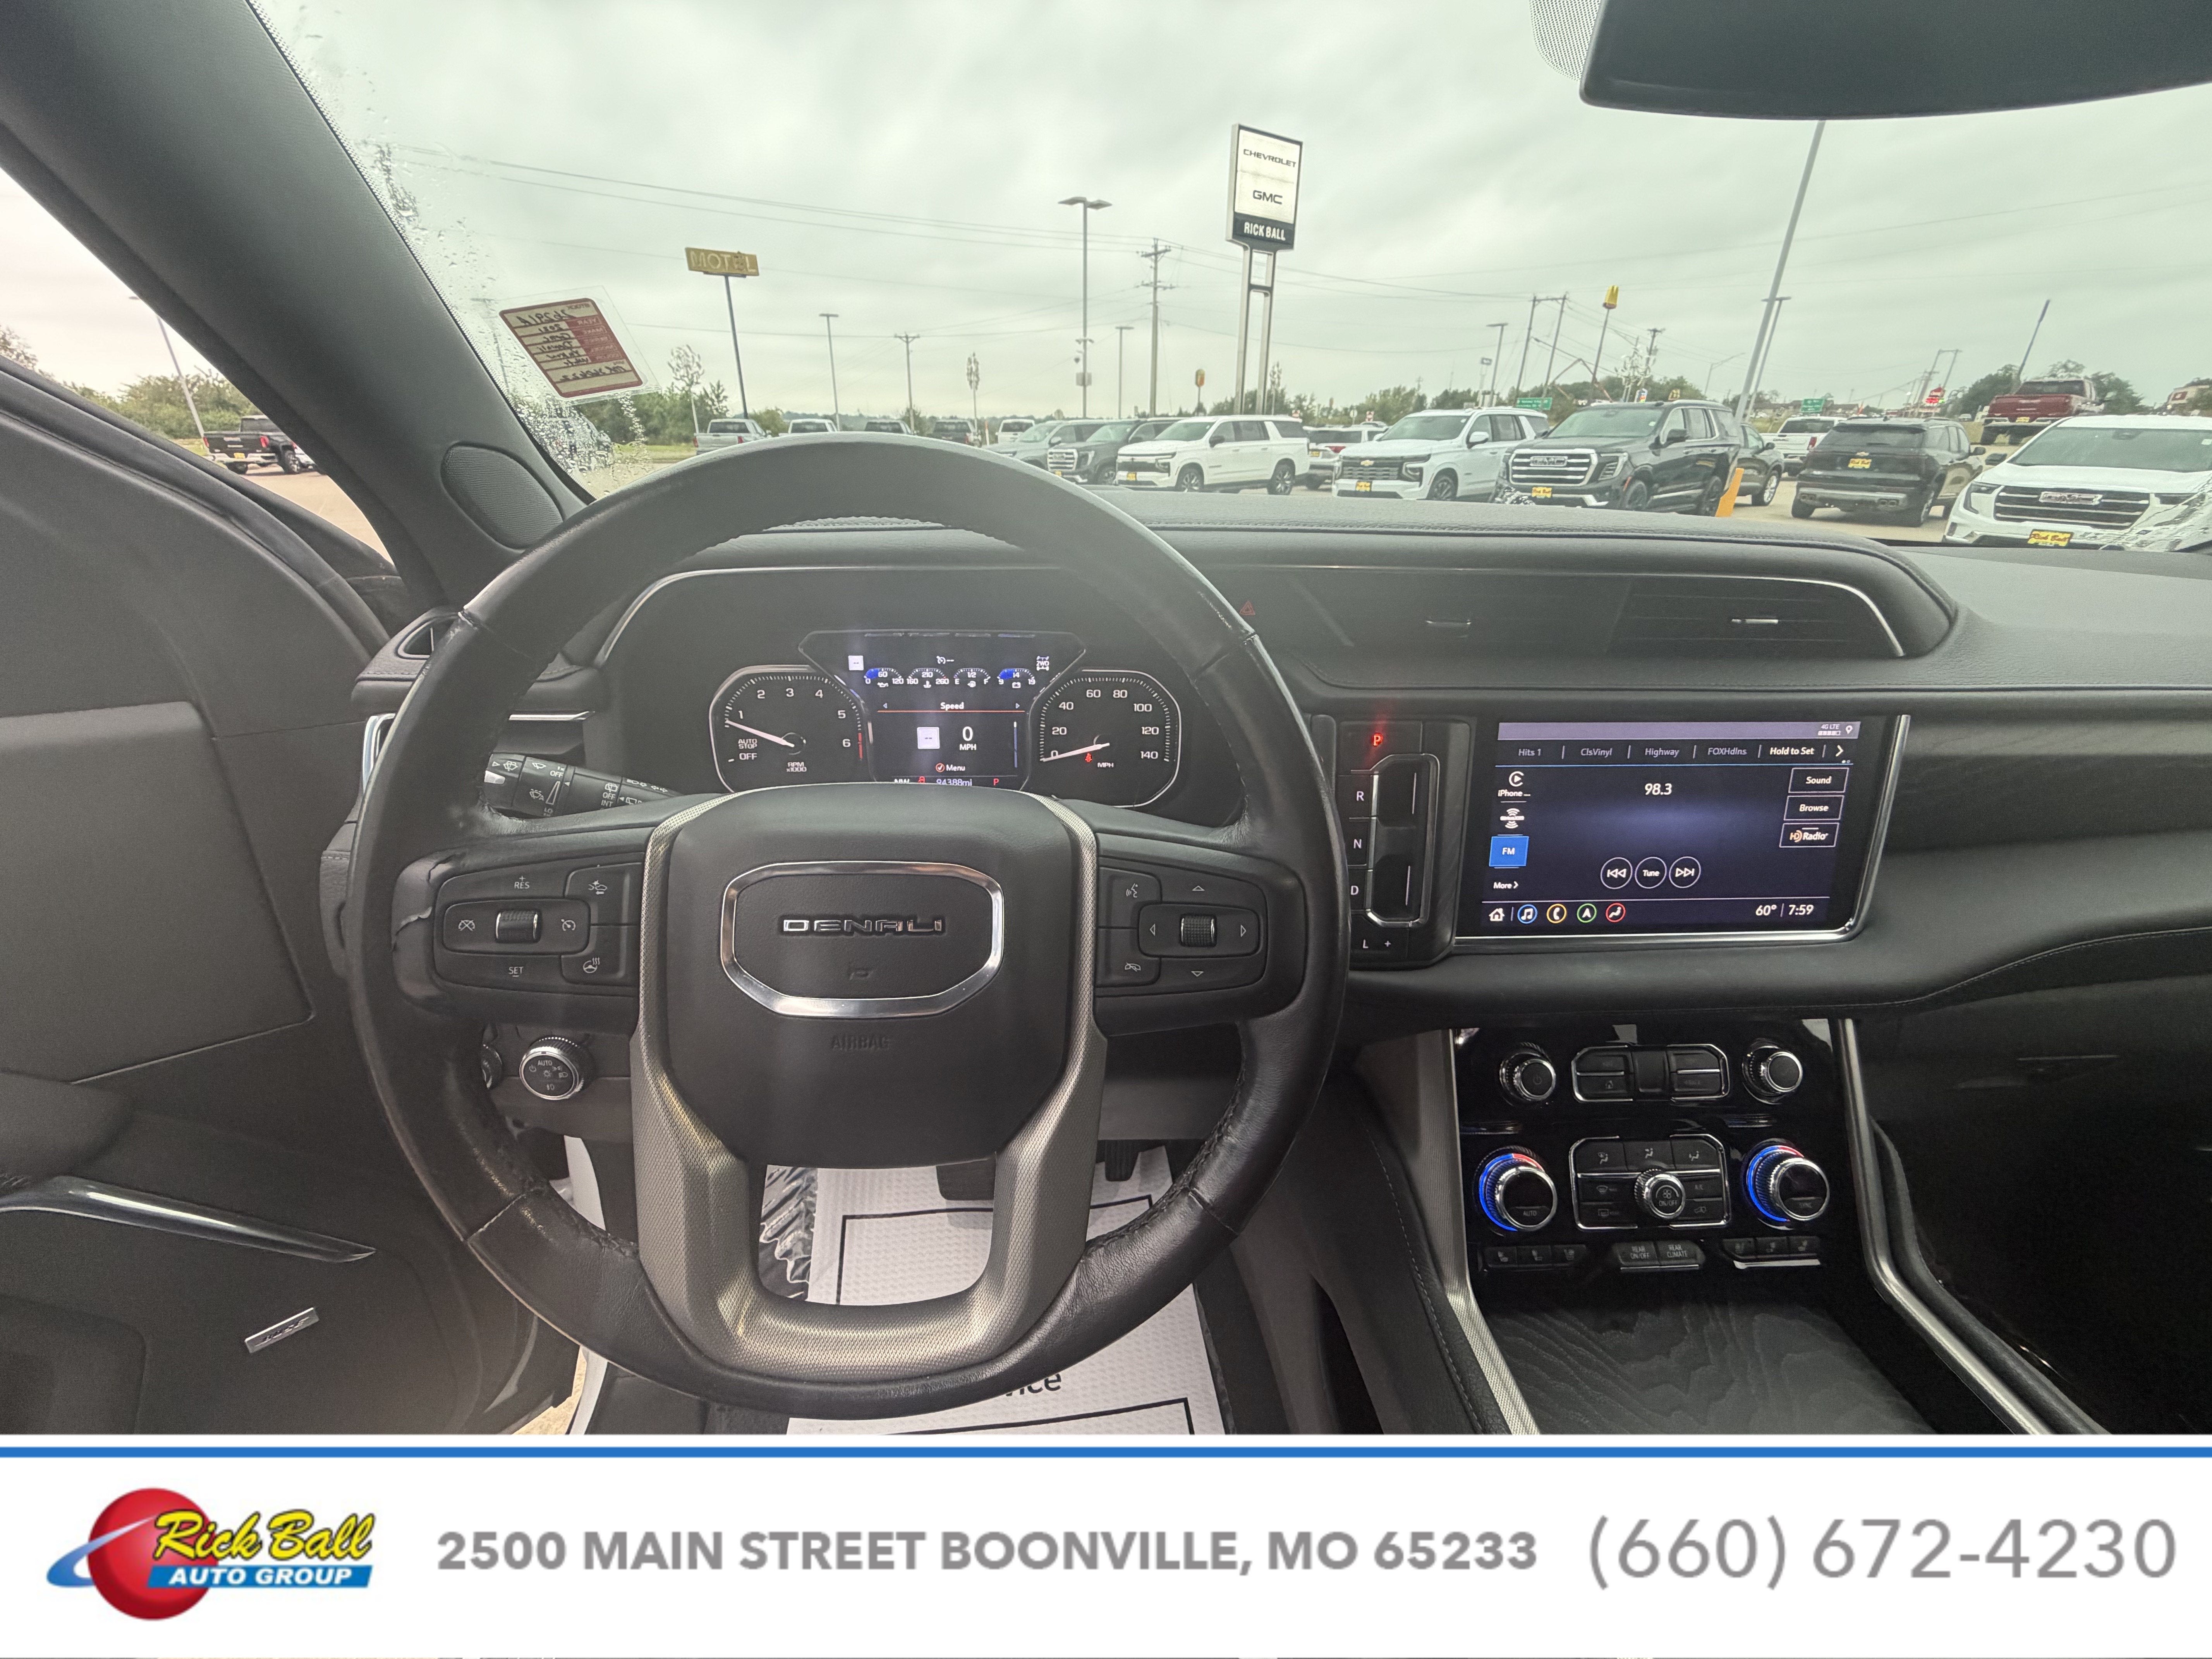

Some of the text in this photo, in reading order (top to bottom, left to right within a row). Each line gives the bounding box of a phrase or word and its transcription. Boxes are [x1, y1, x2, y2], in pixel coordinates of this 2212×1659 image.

[1243, 149, 1297, 168] CHEVROLET
[1252, 189, 1283, 205] GMC
[1243, 222, 1286, 241] RICK BALL
[690, 251, 756, 272] MOTEL
[757, 690, 765, 699] 2
[786, 688, 794, 697] 3
[815, 689, 823, 697] 4
[1086, 689, 1101, 698] 60
[1113, 689, 1128, 698] 80
[940, 702, 965, 711] Speed
[1058, 702, 1074, 711] 40
[1133, 703, 1152, 712] 100
[738, 710, 744, 720] 1
[837, 710, 846, 718] 5
[962, 726, 974, 741] 0
[1051, 726, 1067, 735] 20
[1141, 726, 1159, 735] 120
[843, 738, 851, 748] 6
[1373, 735, 1381, 746] P
[1051, 750, 1058, 758] 0
[1140, 750, 1158, 759] 140
[1580, 748, 1613, 758] ClsVinyl
[1645, 748, 1680, 758] Highway
[1770, 747, 1790, 755] Hold
[1805, 776, 1832, 784] Sound
[1645, 783, 1672, 795] 98.3
[1357, 791, 1364, 801] R
[1790, 830, 1802, 843] HD
[1353, 839, 1362, 849] N
[1350, 885, 1359, 895] D
[1755, 904, 1814, 916] 60° 7:59
[783, 919, 943, 932] DENALI
[1362, 939, 1369, 949] L
[508, 966, 524, 974] SET
[831, 1035, 891, 1050] AIRBAG
